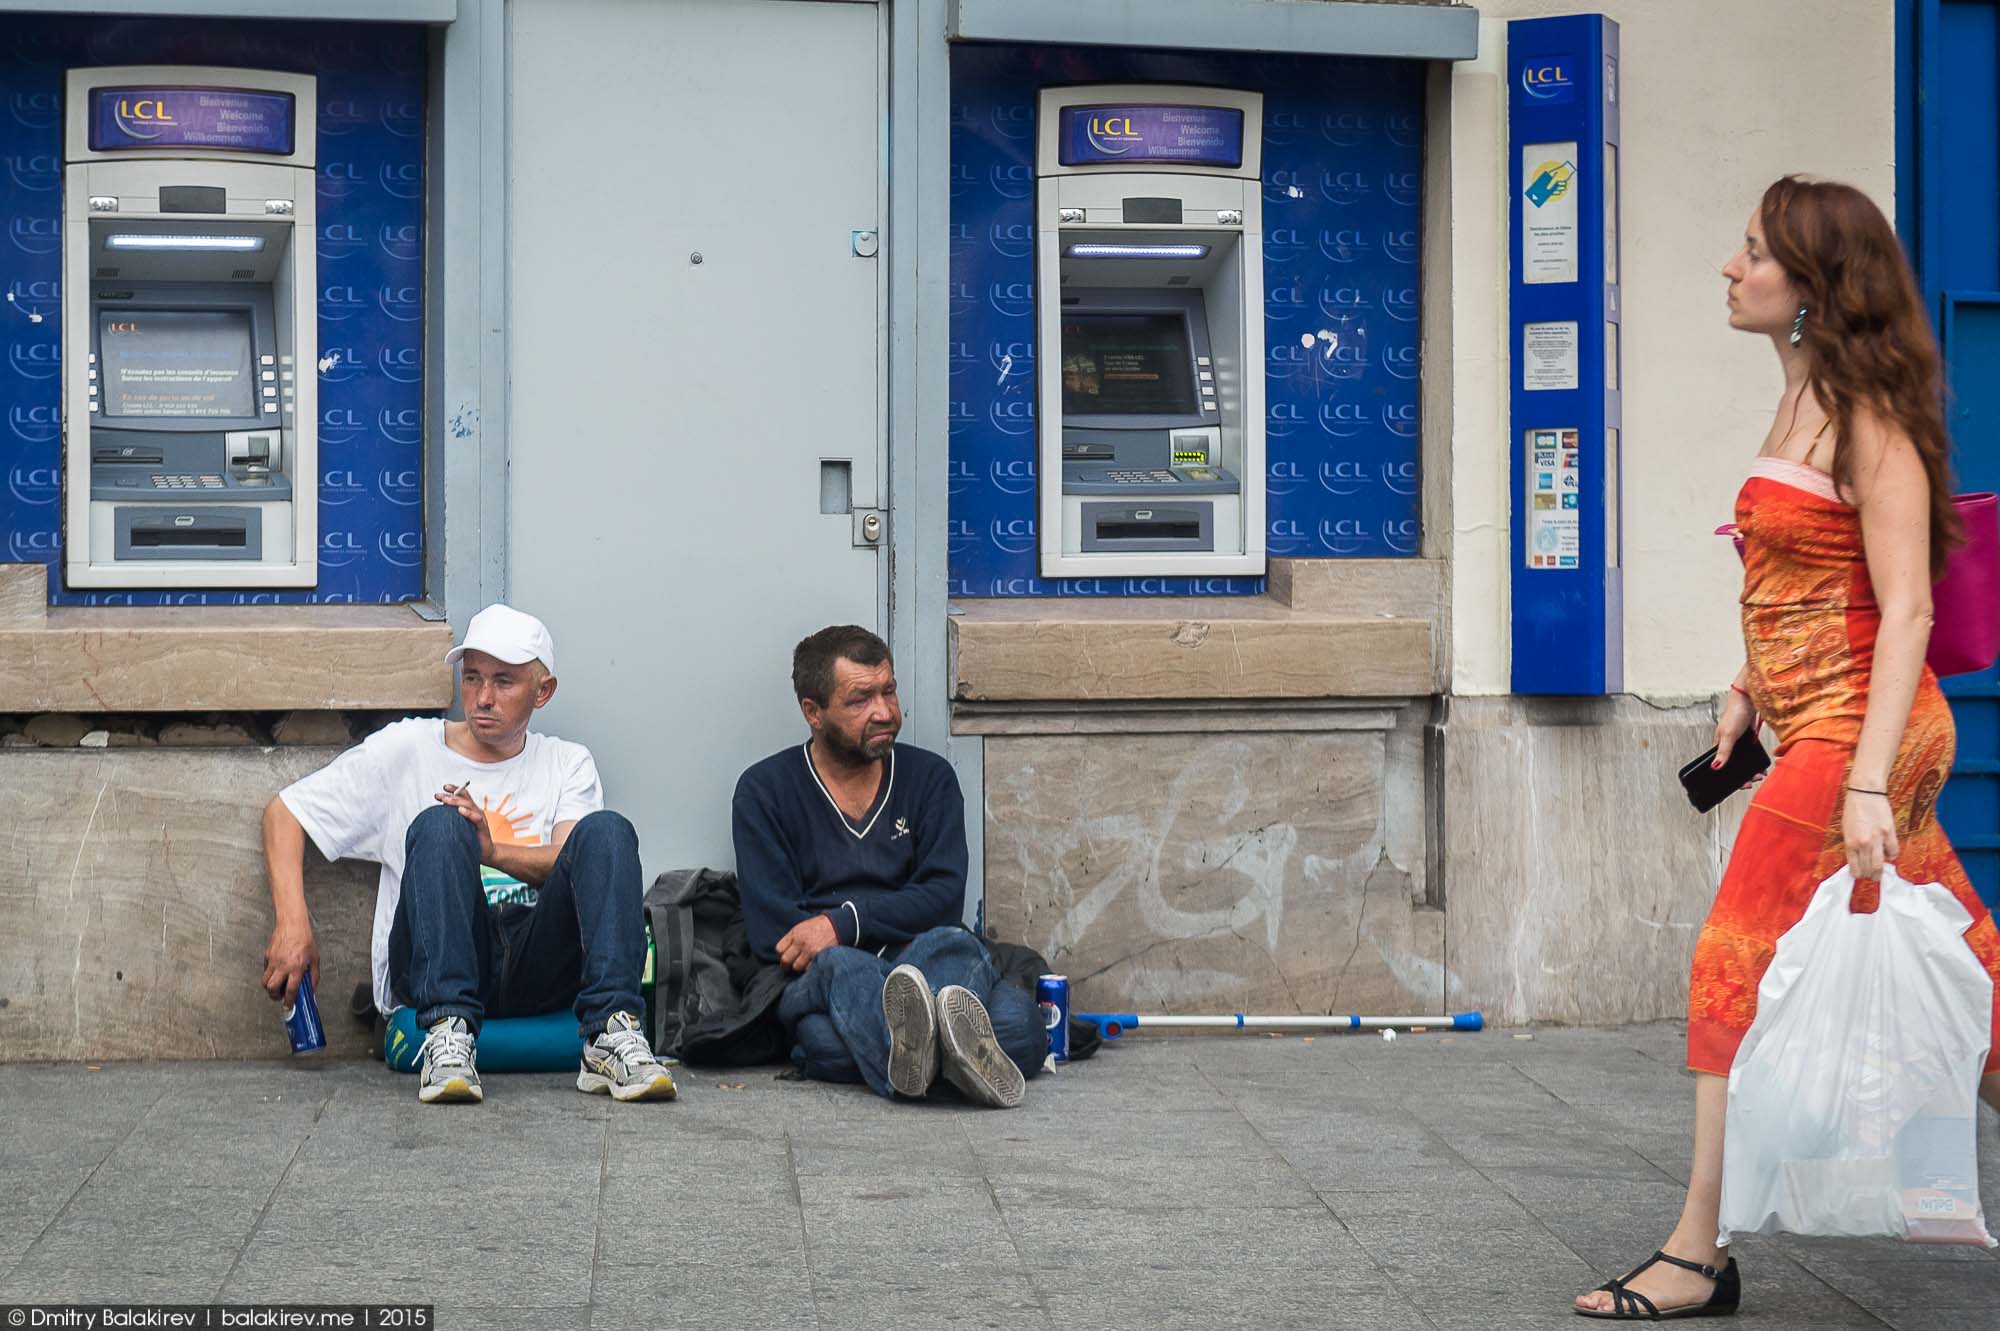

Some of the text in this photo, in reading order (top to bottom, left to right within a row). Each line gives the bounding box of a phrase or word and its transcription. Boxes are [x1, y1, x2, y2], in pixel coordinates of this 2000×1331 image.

[1527, 66, 1568, 84] LCL
[200, 96, 249, 108] Bienvenue
[120, 100, 172, 120] LCL
[219, 109, 264, 121] Welcome
[1162, 112, 1207, 122] Bienvenue
[216, 122, 270, 134] Bienvenido
[1093, 118, 1138, 135] LCL
[1180, 124, 1220, 134] Welcome
[183, 131, 243, 143] Willkommen
[1177, 136, 1224, 146] Bienvenido
[1148, 146, 1201, 155] Willkommen
[318, 225, 362, 240] CL
[385, 226, 421, 242] LC
[1325, 230, 1368, 245] LCL
[1389, 232, 1416, 246] LC
[318, 286, 362, 302] CL
[385, 288, 421, 302] LC
[1325, 288, 1368, 303] LCL
[1389, 289, 1416, 304] LC
[385, 349, 421, 364] LC
[1389, 347, 1416, 362] LC
[318, 409, 362, 425] CL
[385, 410, 421, 425] LC
[1325, 404, 1368, 419] LCL
[1389, 404, 1416, 420] LC
[1325, 462, 1368, 477] LCL
[1389, 462, 1416, 477] LC
[318, 471, 362, 486] CL
[385, 472, 421, 487] LC
[1325, 520, 1368, 535] LCL
[1389, 520, 1416, 535] LC
[318, 532, 362, 548] CL
[385, 532, 421, 548] LC
[996, 578, 1042, 594] LCL
[1063, 579, 1108, 594] LCL
[1129, 578, 1174, 594] LCL
[1195, 578, 1240, 594] LCL
